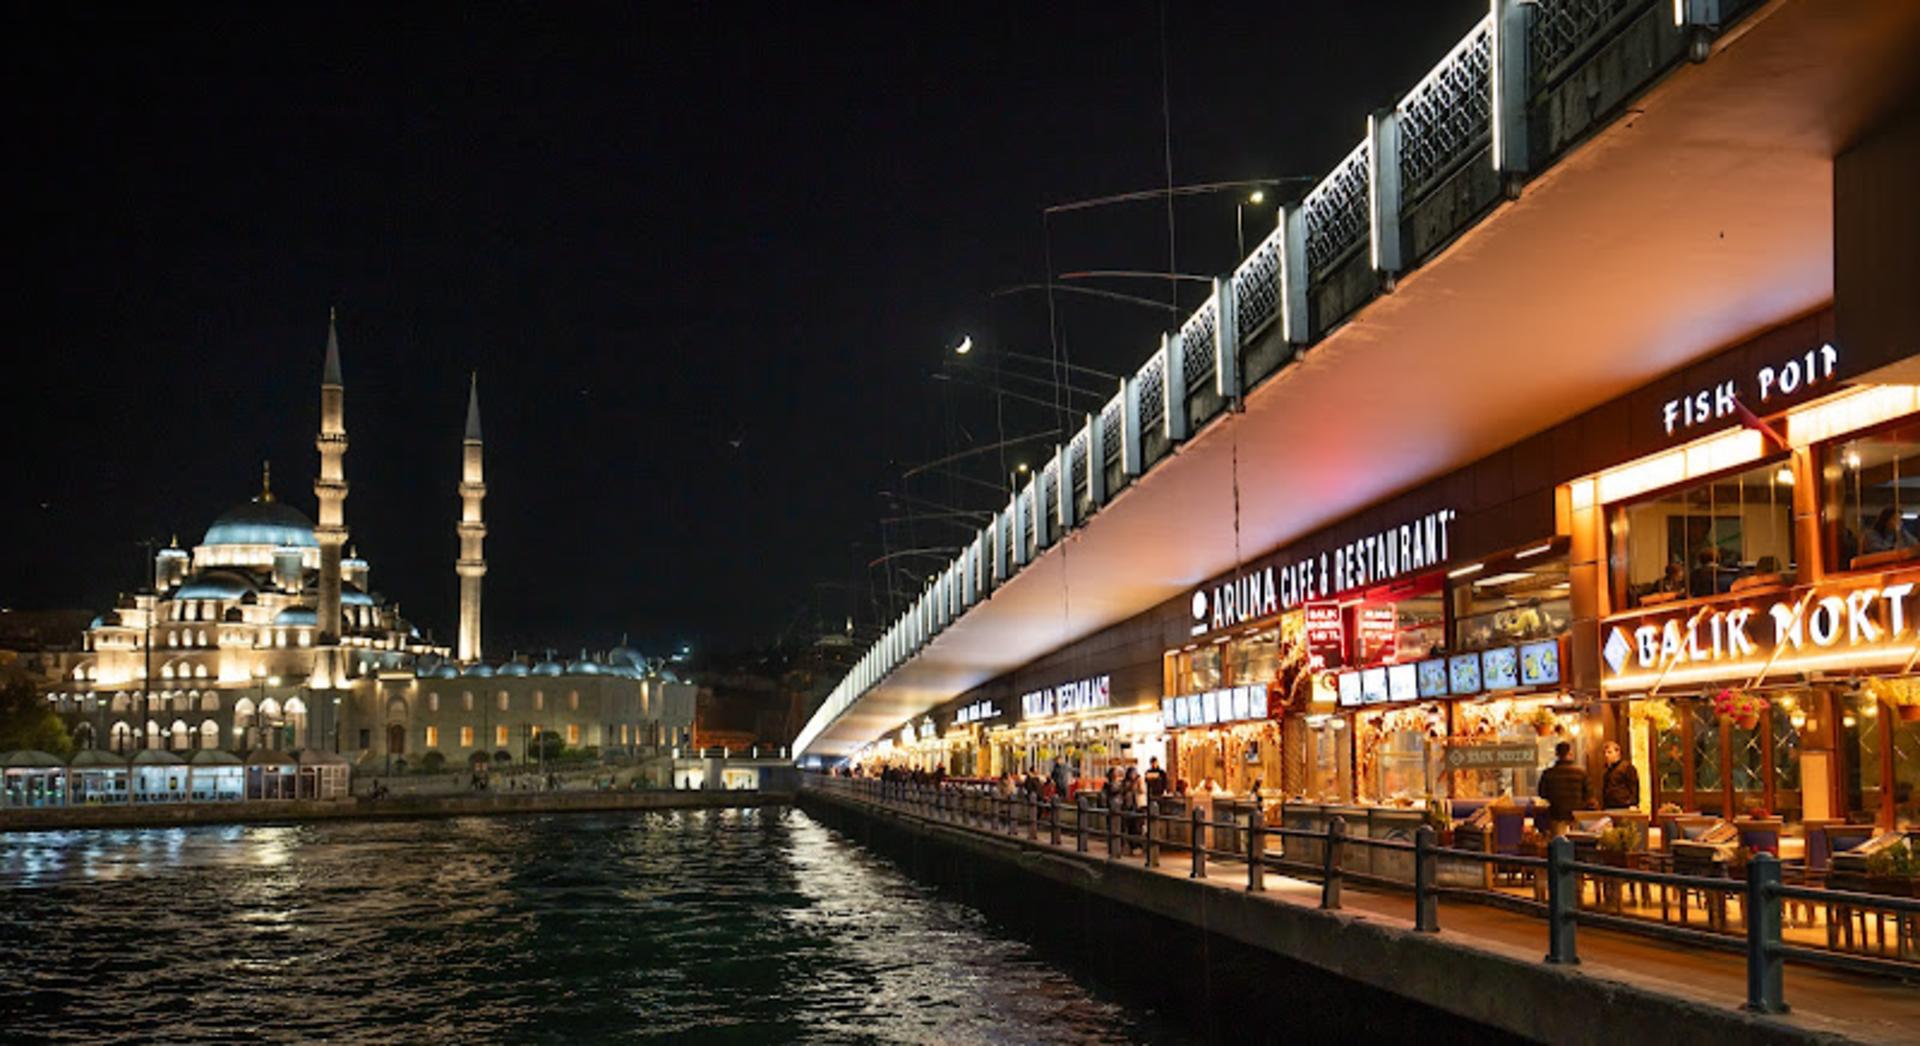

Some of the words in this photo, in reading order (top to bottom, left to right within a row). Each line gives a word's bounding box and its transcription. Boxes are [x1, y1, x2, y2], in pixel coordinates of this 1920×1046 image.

[1663, 379, 1736, 436] FISH
[1212, 566, 1277, 630] ARUNA
[1281, 558, 1315, 609] CAFE
[1335, 509, 1448, 593] RESTAURANT
[1634, 606, 1758, 668] BALIK
[1768, 582, 1915, 650] NOKT
